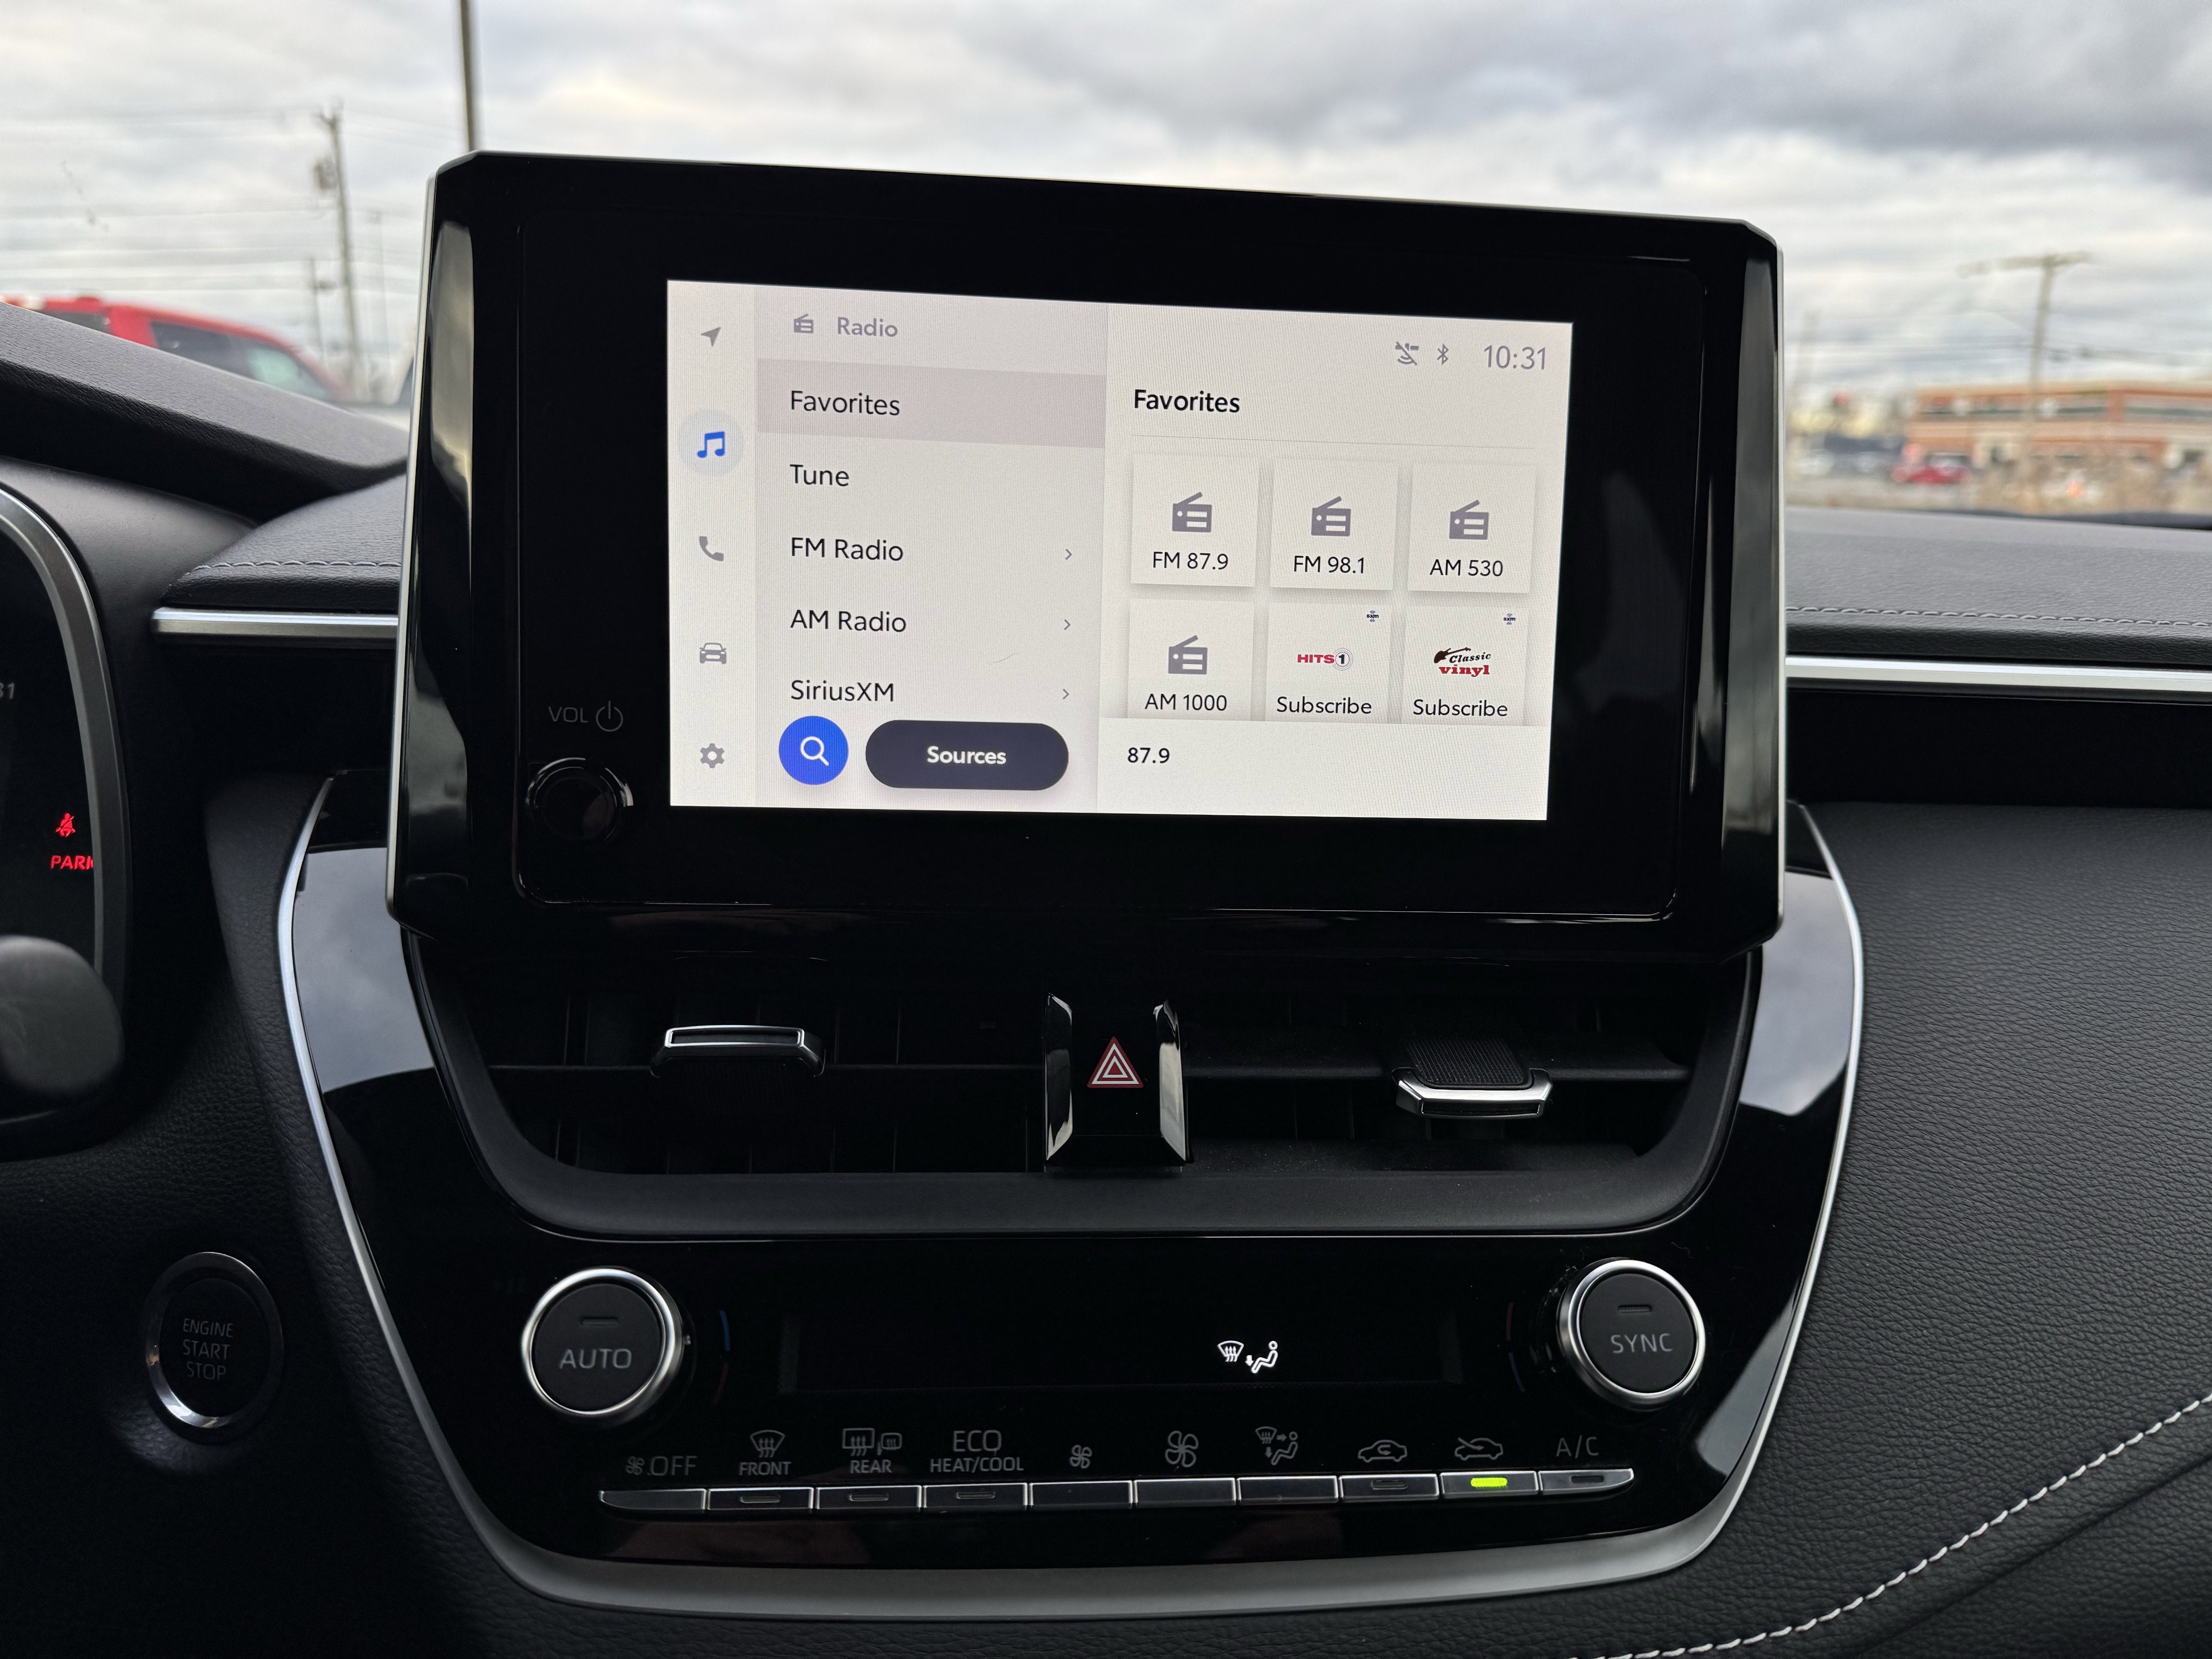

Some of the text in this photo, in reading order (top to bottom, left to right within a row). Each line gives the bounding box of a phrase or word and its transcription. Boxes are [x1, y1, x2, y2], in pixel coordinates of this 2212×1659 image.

[838, 316, 898, 337] Radio
[1484, 345, 1546, 370] 10:31
[791, 390, 900, 416] Favorites
[1134, 389, 1240, 413] Favorites
[790, 464, 849, 487] Tune
[792, 537, 903, 561] FM Radio
[1153, 551, 1228, 570] FM 87.9
[1294, 555, 1364, 574] FM 98.1
[1429, 559, 1503, 577] AM 530
[790, 609, 907, 632] AM Radio
[1449, 652, 1491, 663] Classic
[1439, 664, 1490, 677] vinyl
[791, 679, 894, 702] SiriusXM
[1145, 693, 1227, 711] AM 1000
[1277, 696, 1372, 714] Subscribe
[1413, 699, 1508, 717] Subscribe
[548, 706, 588, 723] VOL
[927, 745, 1006, 764] Sources
[1127, 747, 1170, 764] 87.9
[183, 1318, 234, 1338] ENGINE
[183, 1339, 231, 1360] START
[1611, 1333, 1672, 1353] SYNC
[560, 1348, 632, 1369] AUTO
[186, 1361, 226, 1380] STOP
[953, 1429, 1002, 1452] ECO
[1556, 1435, 1599, 1459] A/C
[650, 1455, 697, 1476] OFF
[739, 1461, 791, 1475] FRONT
[850, 1459, 892, 1474] REAR
[930, 1456, 1024, 1473] HEAT/COOL
